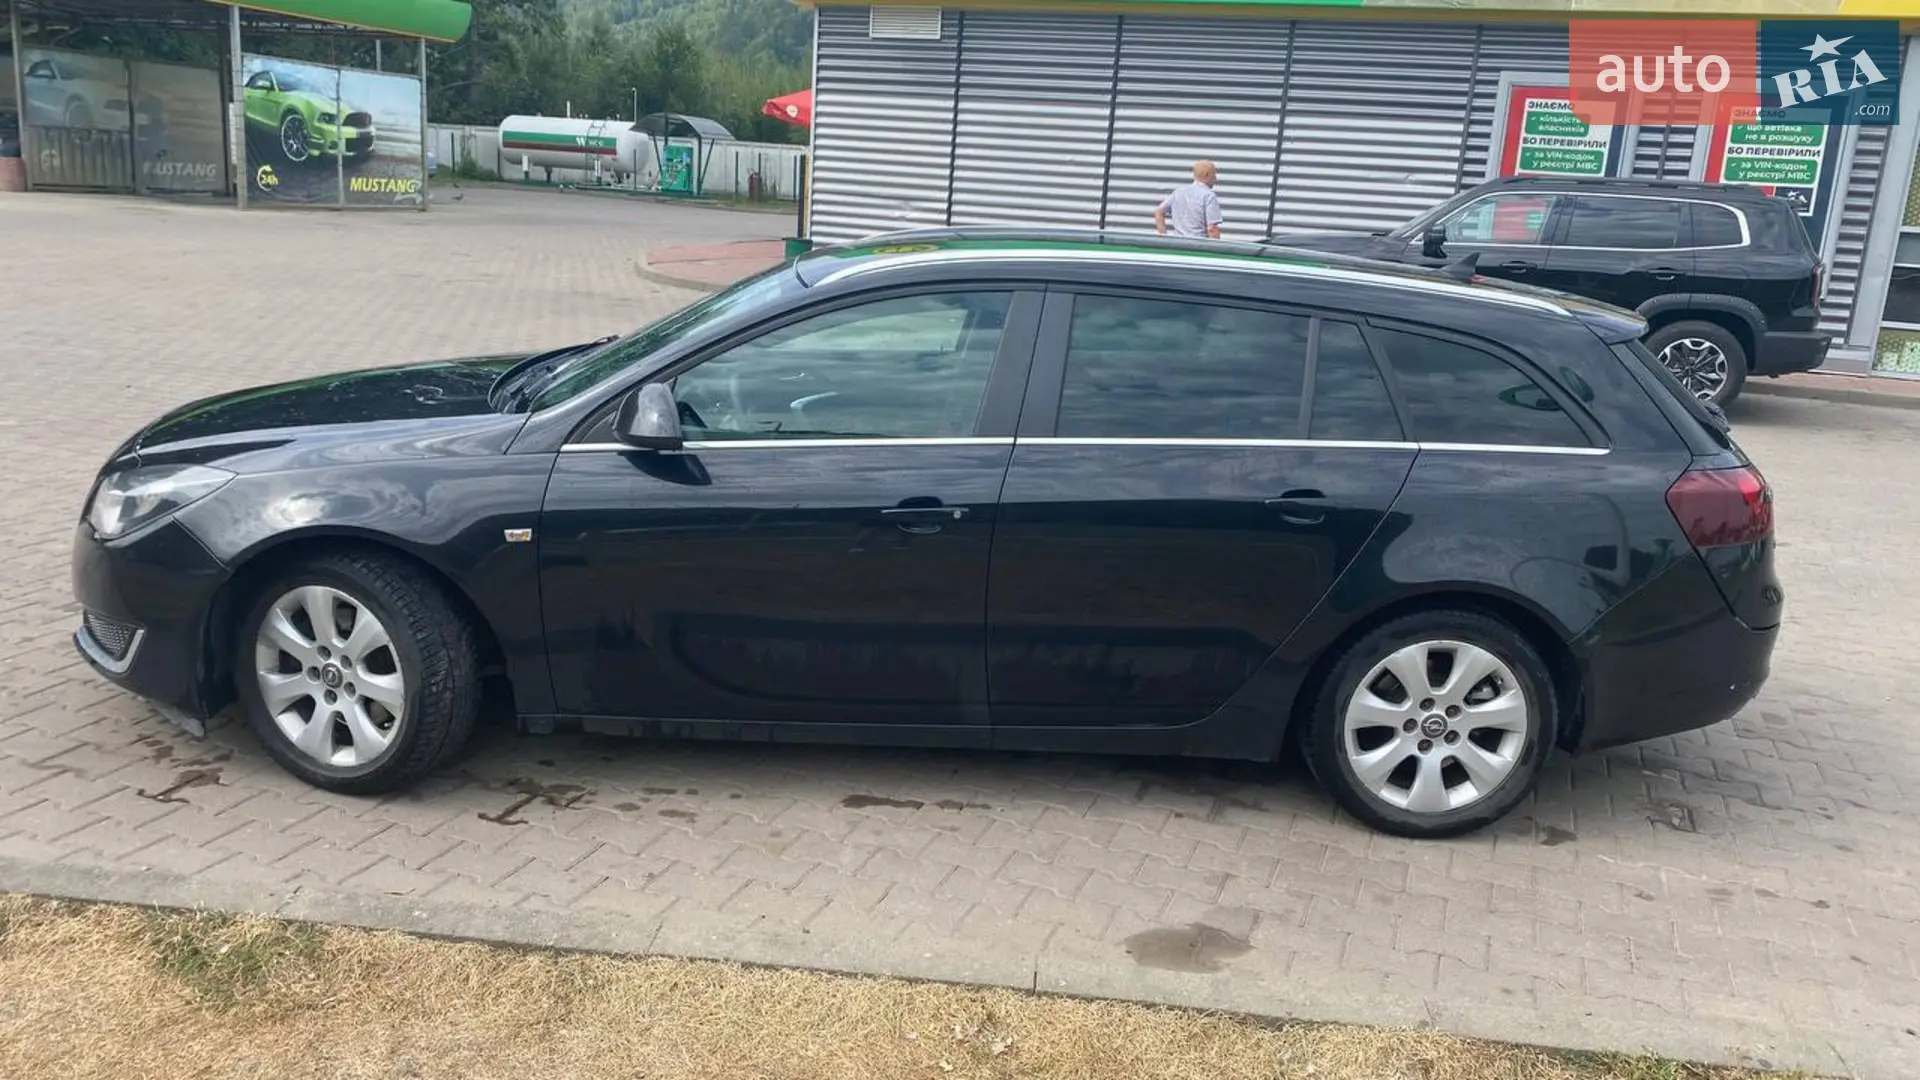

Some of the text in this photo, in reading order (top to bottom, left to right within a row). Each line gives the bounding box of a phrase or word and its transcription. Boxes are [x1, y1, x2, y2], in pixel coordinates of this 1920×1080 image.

[1523, 137, 1608, 149] БО ПЕРЕВІРИЛИ
[1546, 150, 1595, 161] VIN-кодом
[1728, 146, 1821, 157] БО ПЕРЕВІРИЛИ
[1576, 161, 1599, 170] МВС
[1753, 161, 1808, 171] VIN-кодом
[1787, 171, 1811, 180] МВС
[350, 177, 416, 193] MUSTANG
